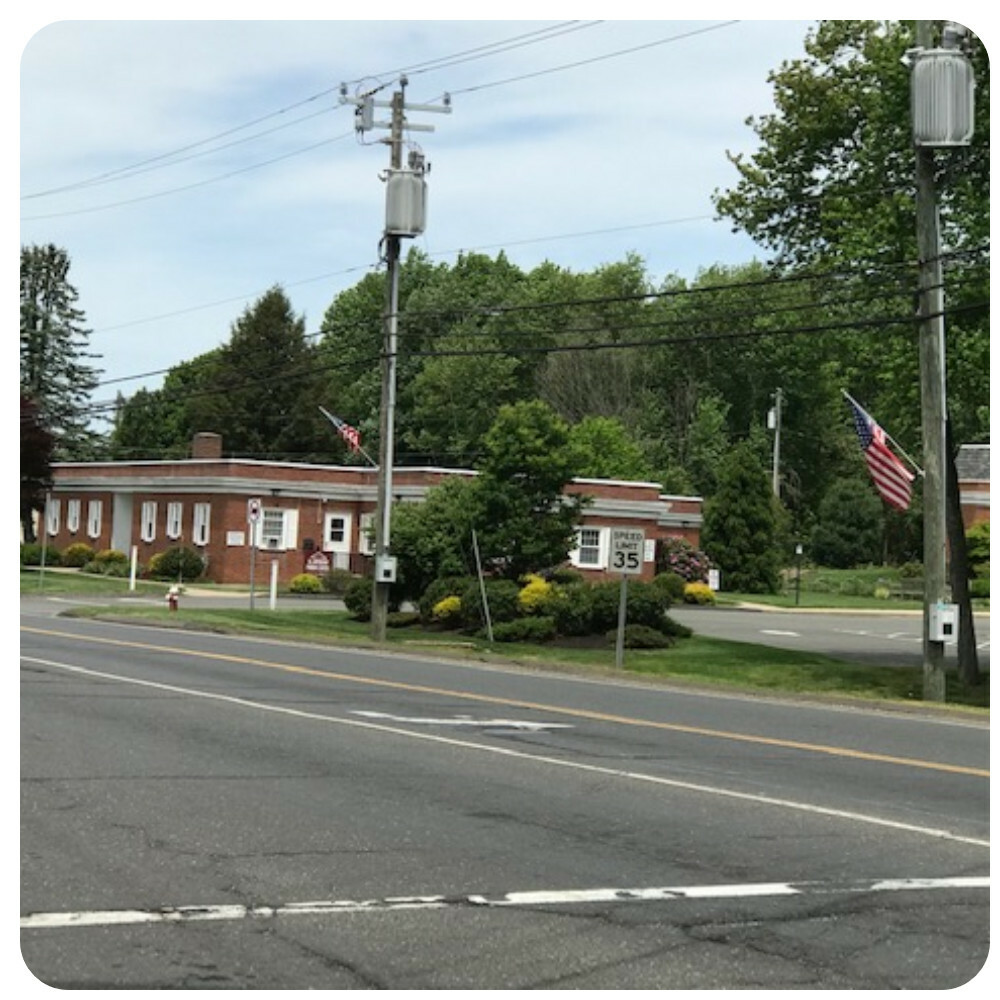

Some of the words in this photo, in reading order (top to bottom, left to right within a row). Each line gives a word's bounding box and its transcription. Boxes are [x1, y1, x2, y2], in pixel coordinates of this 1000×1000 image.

[614, 531, 642, 540] SPEED
[615, 541, 638, 550] LIMIT
[613, 551, 639, 569] 35
